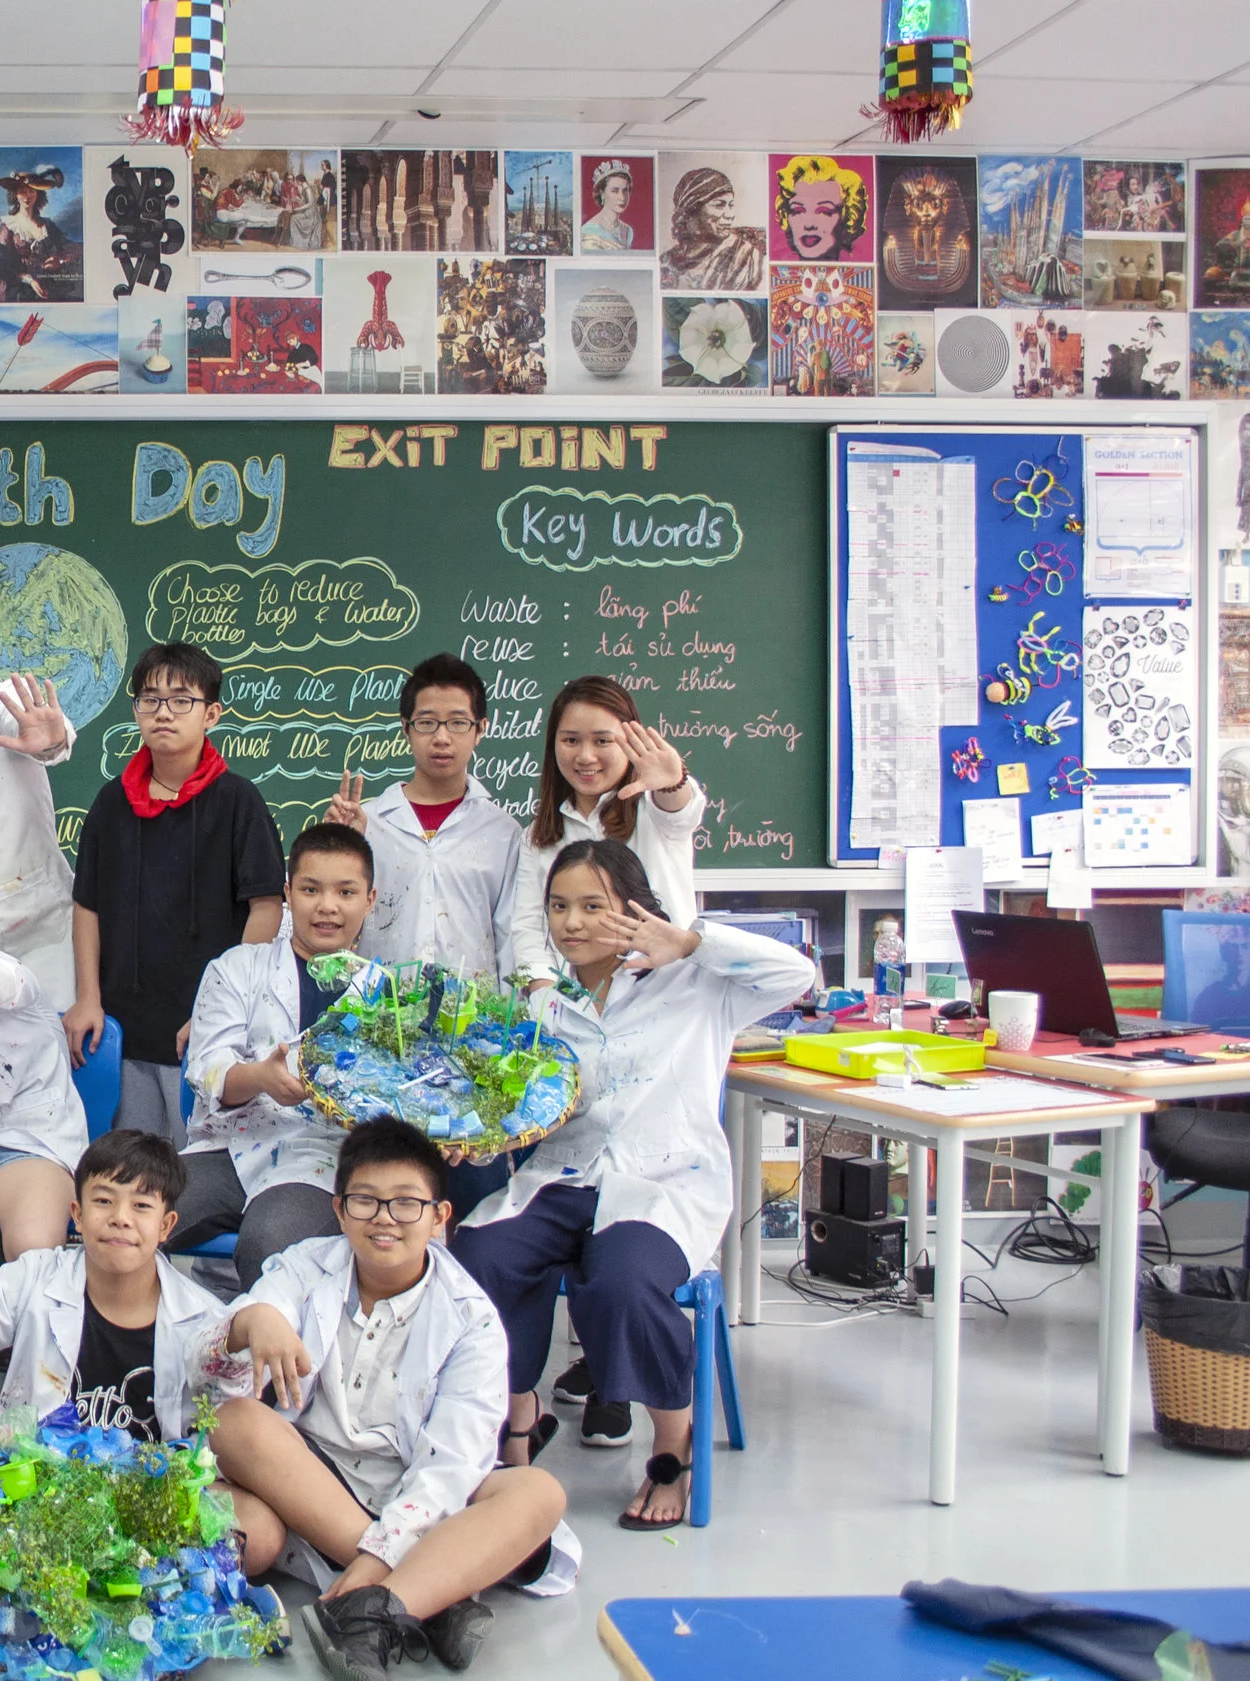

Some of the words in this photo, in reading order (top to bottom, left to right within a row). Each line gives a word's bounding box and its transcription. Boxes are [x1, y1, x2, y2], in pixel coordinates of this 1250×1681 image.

[132, 441, 286, 558] Day
[521, 501, 586, 561] Key
[612, 506, 724, 548] Words
[259, 578, 279, 604] to
[290, 574, 364, 603] reduce
[255, 604, 297, 636] bags
[662, 590, 703, 628] phí
[182, 621, 245, 645] bottles
[1136, 654, 1184, 674] Value
[482, 669, 543, 701] duce
[75, 1385, 133, 1431] ello
